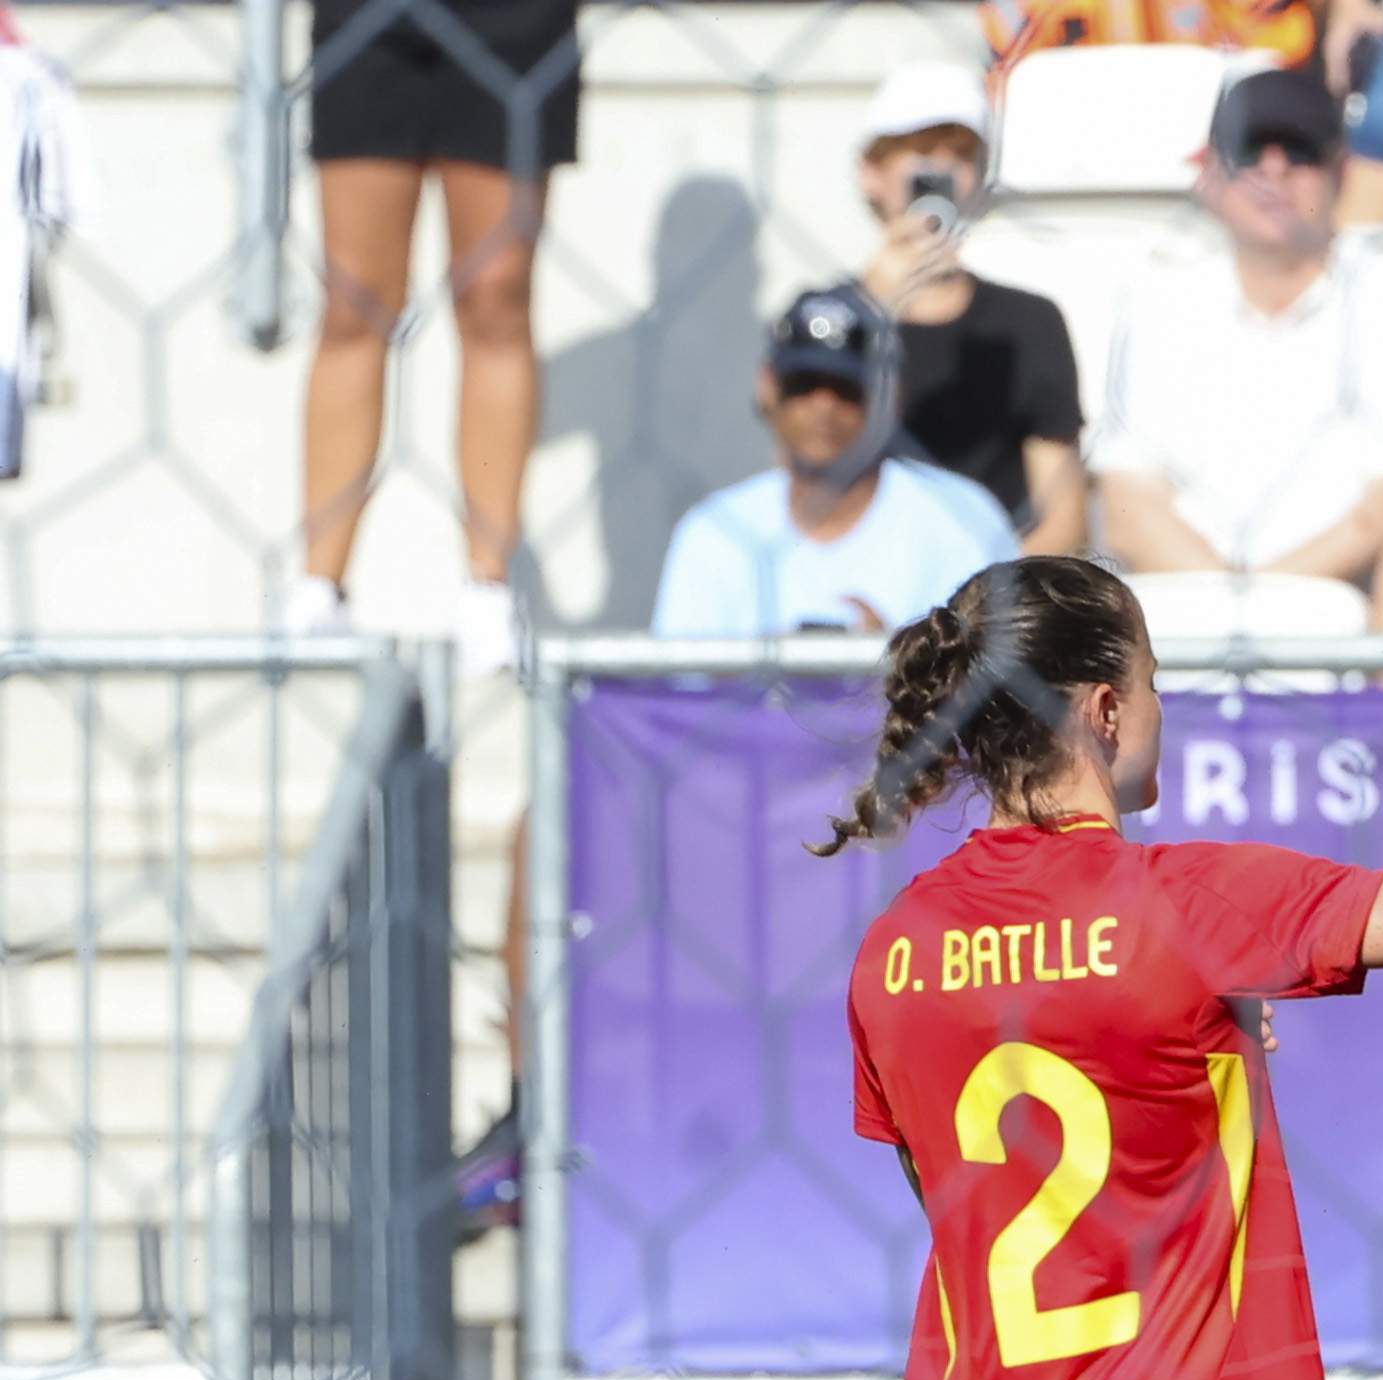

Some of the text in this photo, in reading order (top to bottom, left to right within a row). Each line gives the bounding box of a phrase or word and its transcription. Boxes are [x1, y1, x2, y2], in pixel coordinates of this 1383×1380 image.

[1141, 738, 1380, 826] RIS
[885, 916, 1118, 995] O. BATLLE
[955, 1041, 1140, 1368] 2
